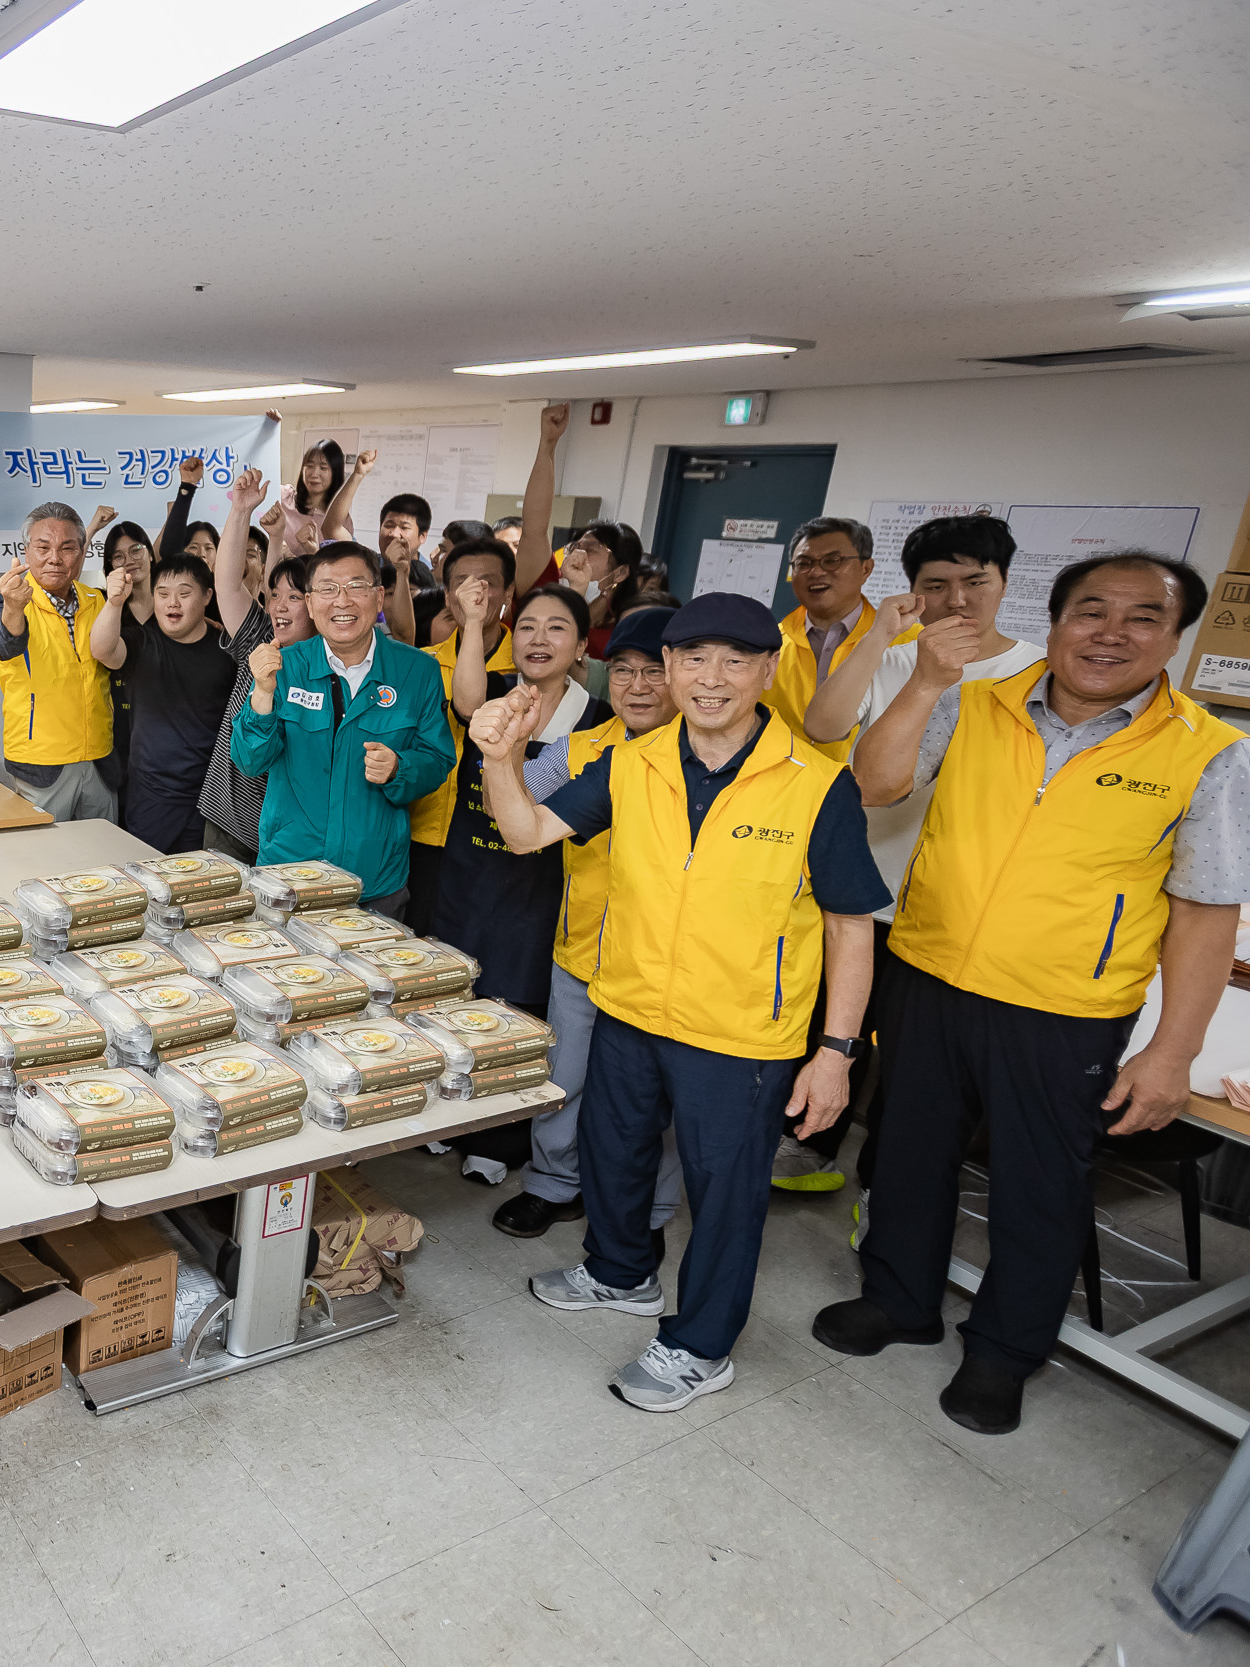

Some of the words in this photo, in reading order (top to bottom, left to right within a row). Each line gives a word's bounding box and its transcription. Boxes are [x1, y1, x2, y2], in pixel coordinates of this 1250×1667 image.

[5, 447, 110, 487] 자라는
[117, 445, 248, 487] 건강상
[1126, 778, 1171, 794] 광진구
[757, 826, 795, 840] 광진구
[471, 836, 487, 848] TEL.
